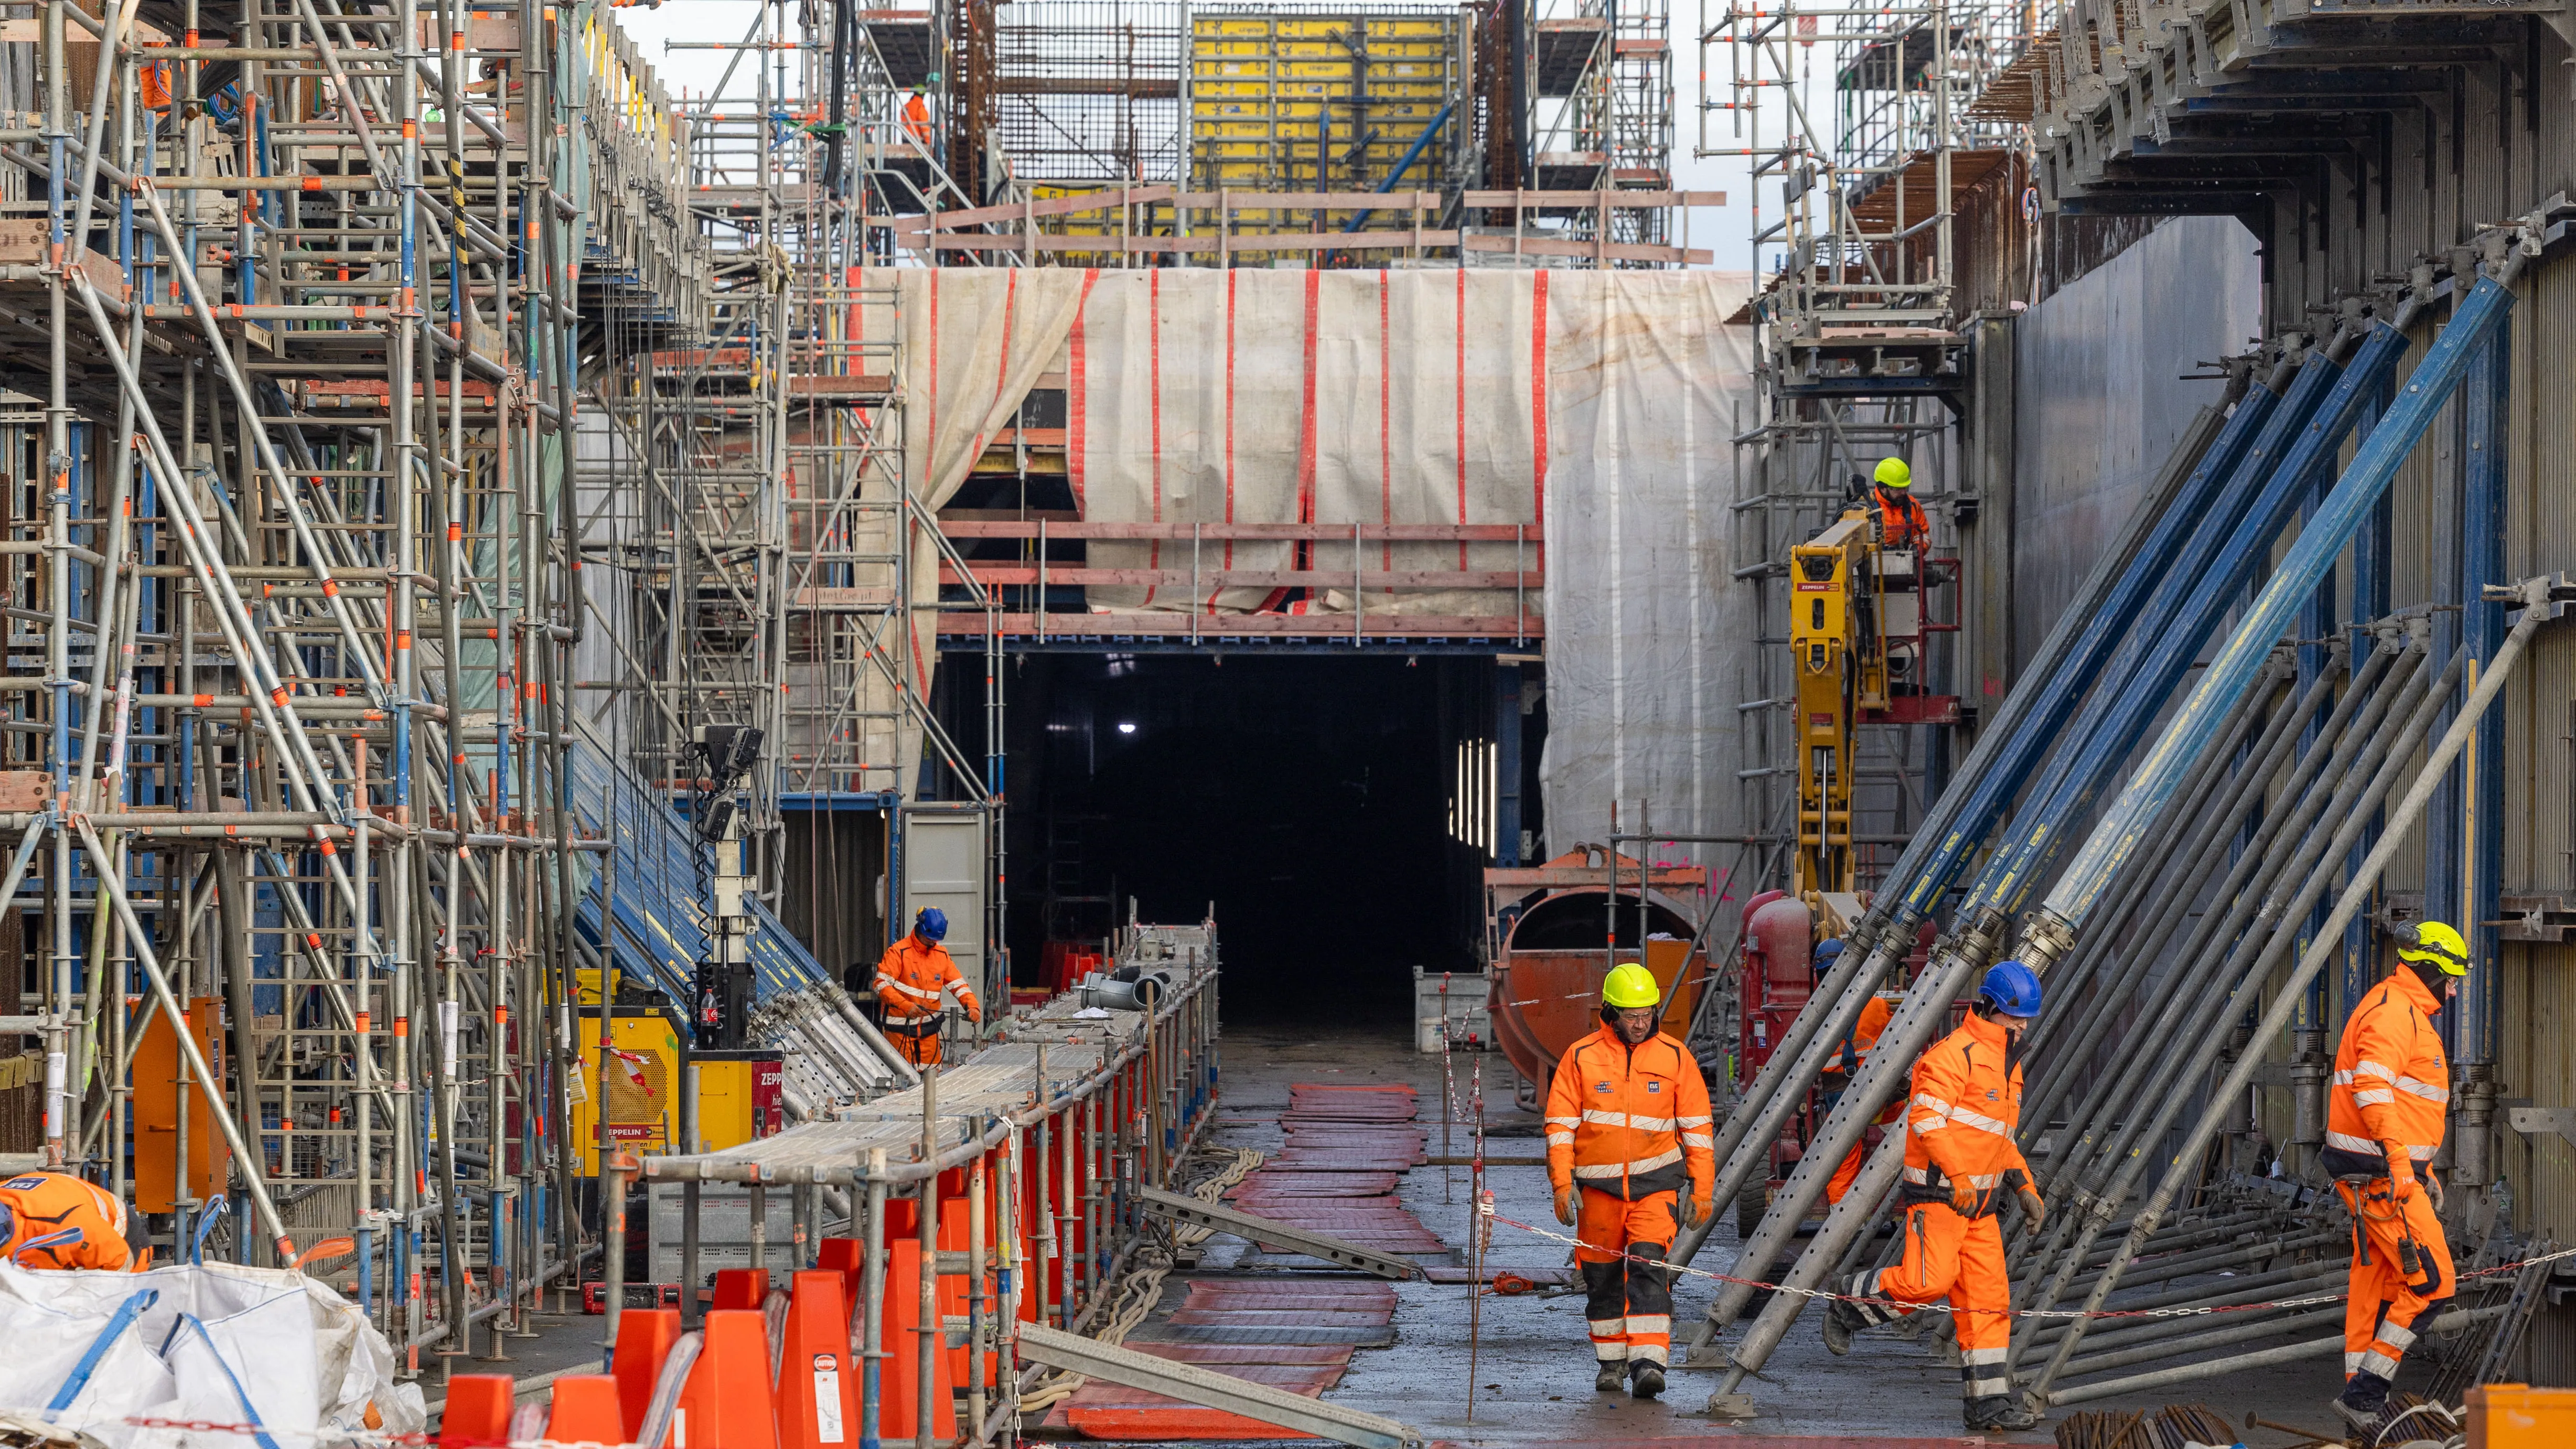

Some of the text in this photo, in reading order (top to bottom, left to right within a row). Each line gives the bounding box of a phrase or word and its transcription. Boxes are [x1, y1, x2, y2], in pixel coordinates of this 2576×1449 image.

[1927, 861, 1939, 875] Eurex
[2012, 846, 2031, 871] Eurex 60
